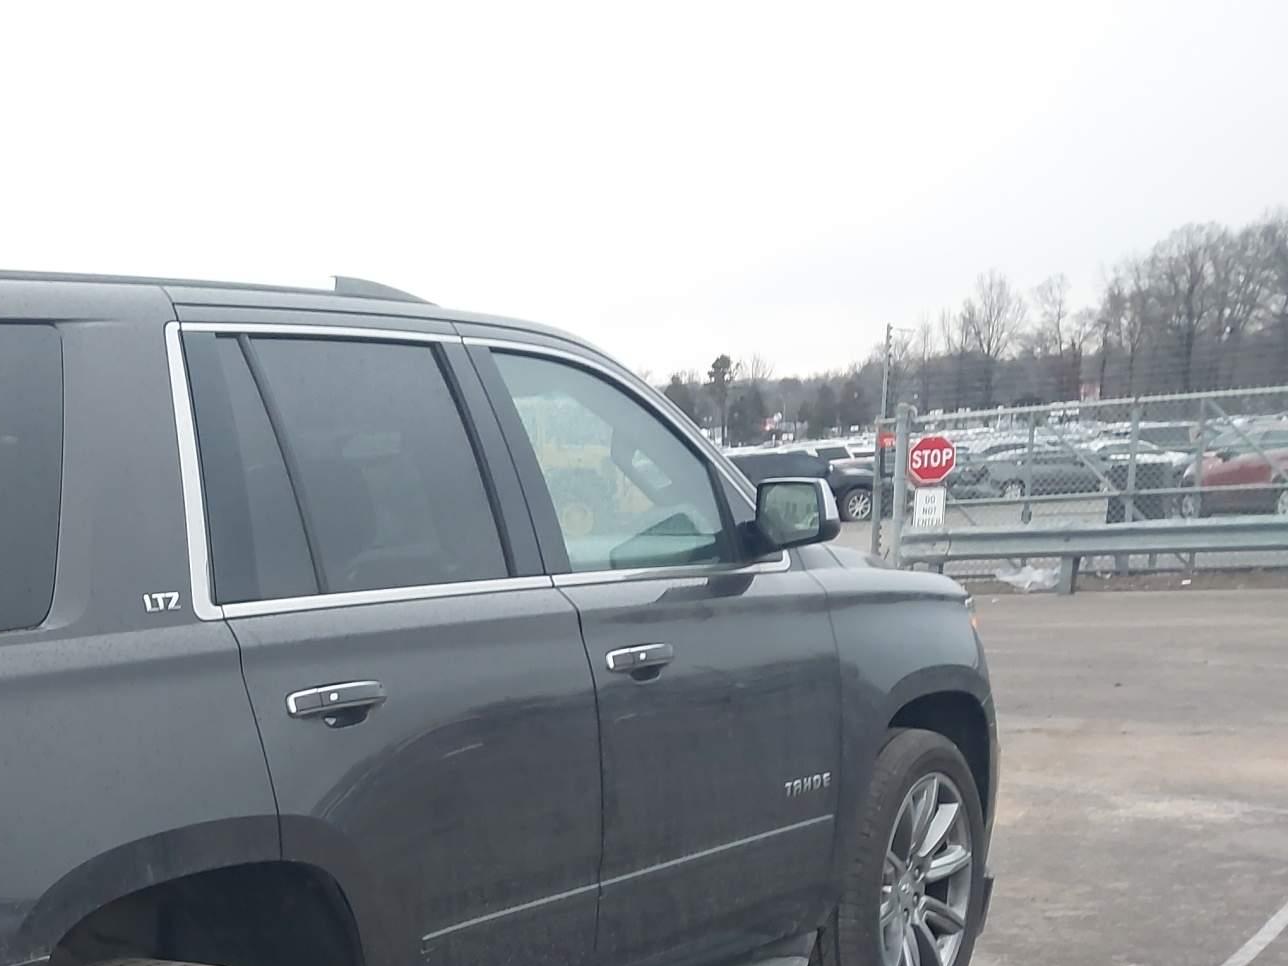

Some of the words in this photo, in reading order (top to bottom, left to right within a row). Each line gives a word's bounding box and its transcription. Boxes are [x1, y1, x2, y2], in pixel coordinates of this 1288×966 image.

[912, 447, 953, 469] STOP
[925, 495, 936, 504] DO
[143, 591, 182, 613] LTZ
[784, 772, 832, 798] TAHOE
